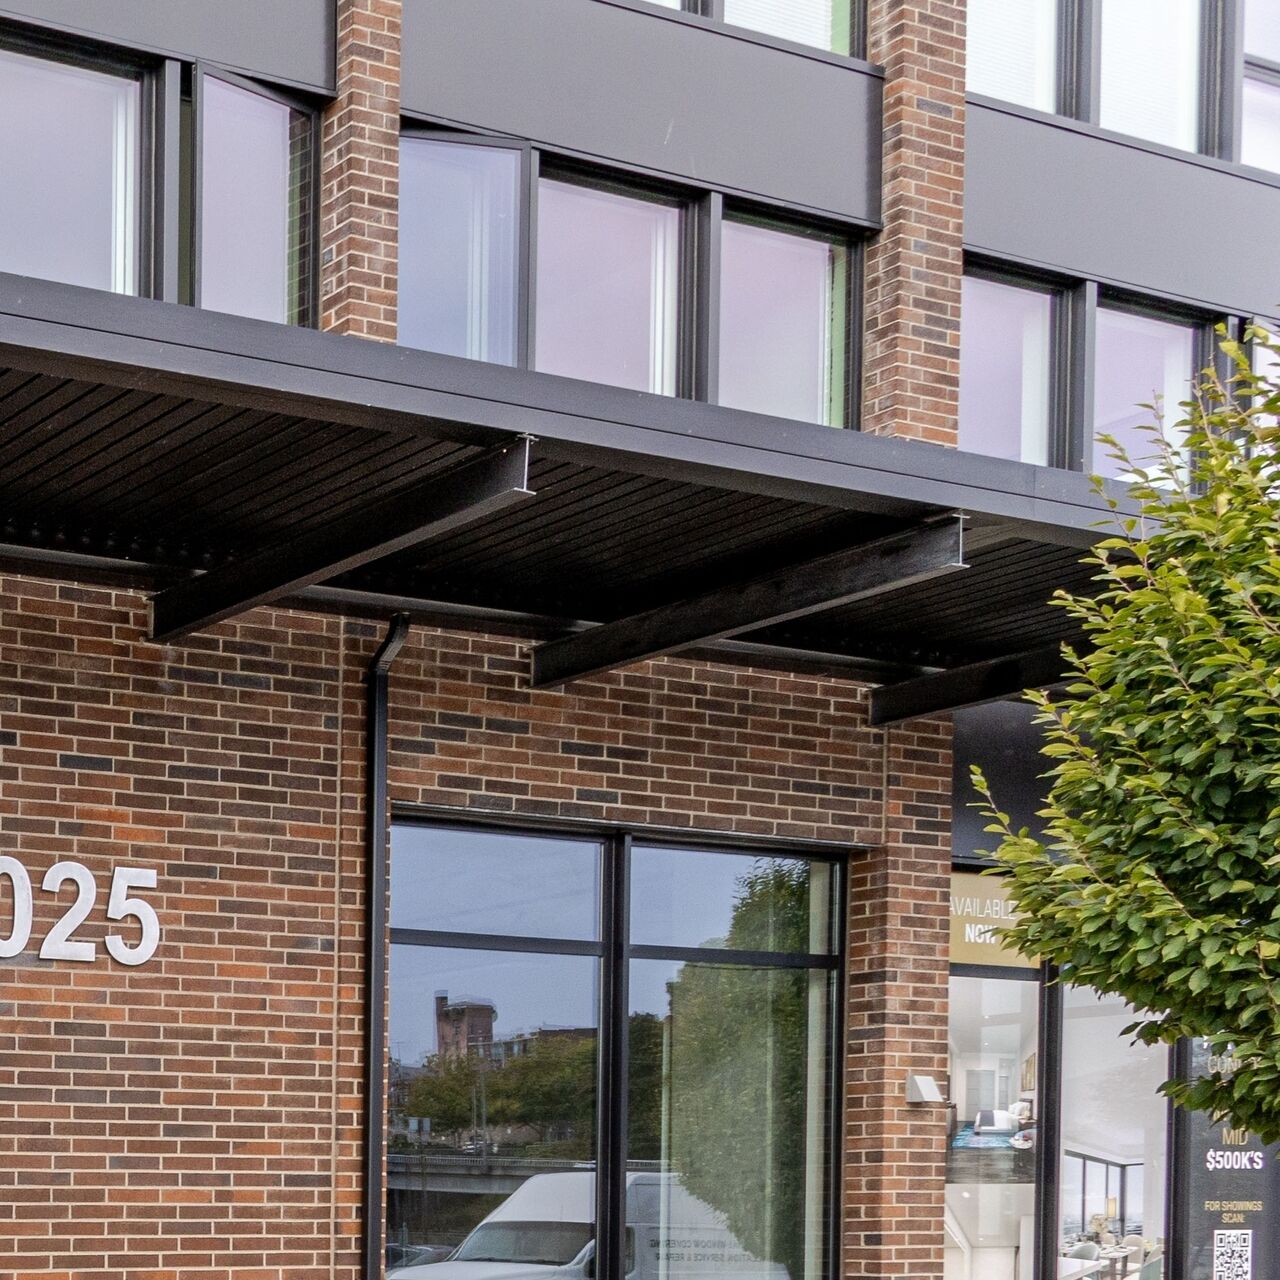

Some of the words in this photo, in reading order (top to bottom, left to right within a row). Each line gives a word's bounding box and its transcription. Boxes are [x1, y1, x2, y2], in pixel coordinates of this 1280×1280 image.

[1222, 1127, 1249, 1145] MID
[1206, 1149, 1264, 1170] $500K'S
[1204, 1201, 1220, 1211] FOR
[1221, 1201, 1264, 1211] SHOWINGS
